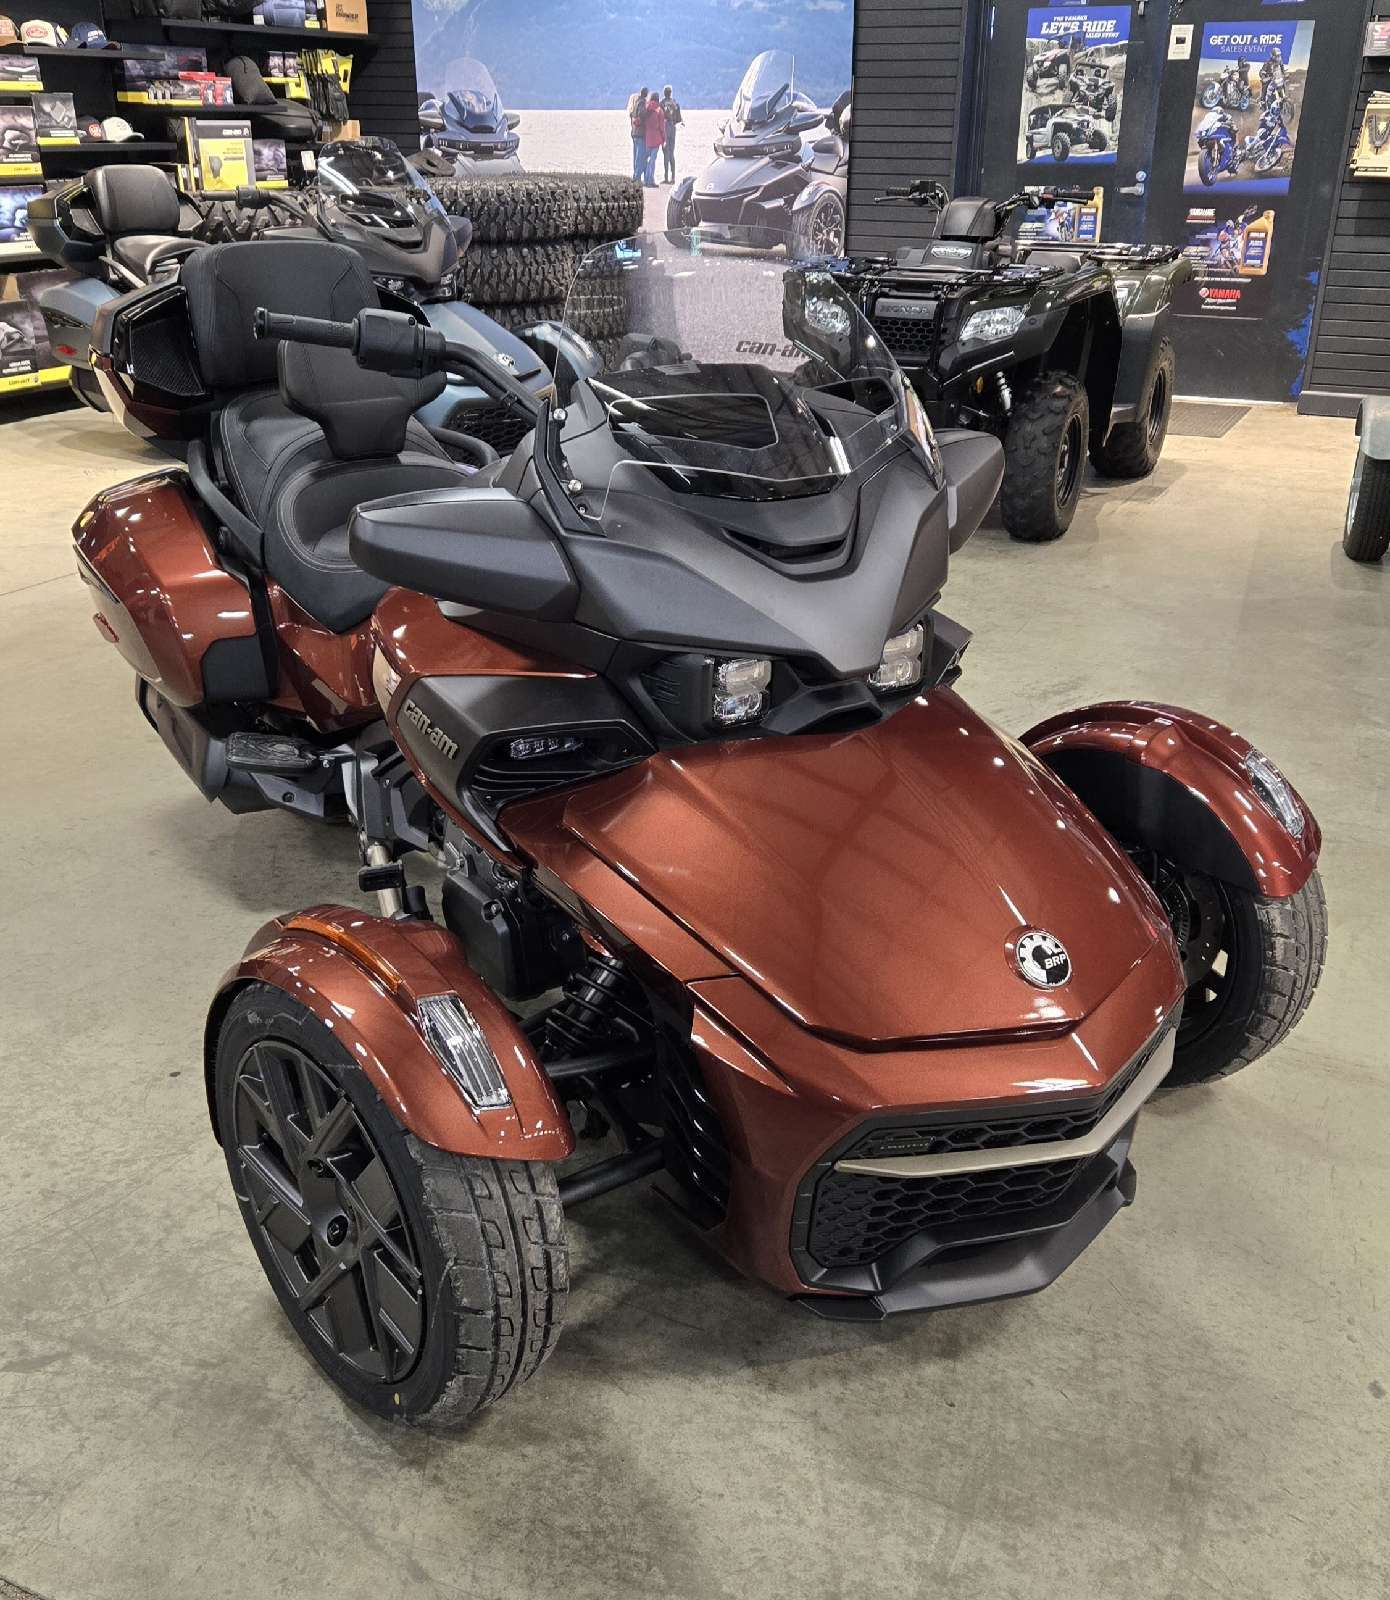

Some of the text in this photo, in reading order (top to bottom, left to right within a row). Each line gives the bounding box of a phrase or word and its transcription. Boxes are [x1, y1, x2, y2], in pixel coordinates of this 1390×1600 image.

[1041, 20, 1116, 34] LET'S RIDE
[1210, 35, 1229, 45] GET
[1231, 35, 1252, 45] OUT
[1260, 35, 1282, 45] RIDE
[1221, 45, 1266, 53] SALES EVENT
[1209, 288, 1240, 299] YAMAHA
[404, 699, 458, 760] can-am
[1044, 953, 1066, 970] BRP
